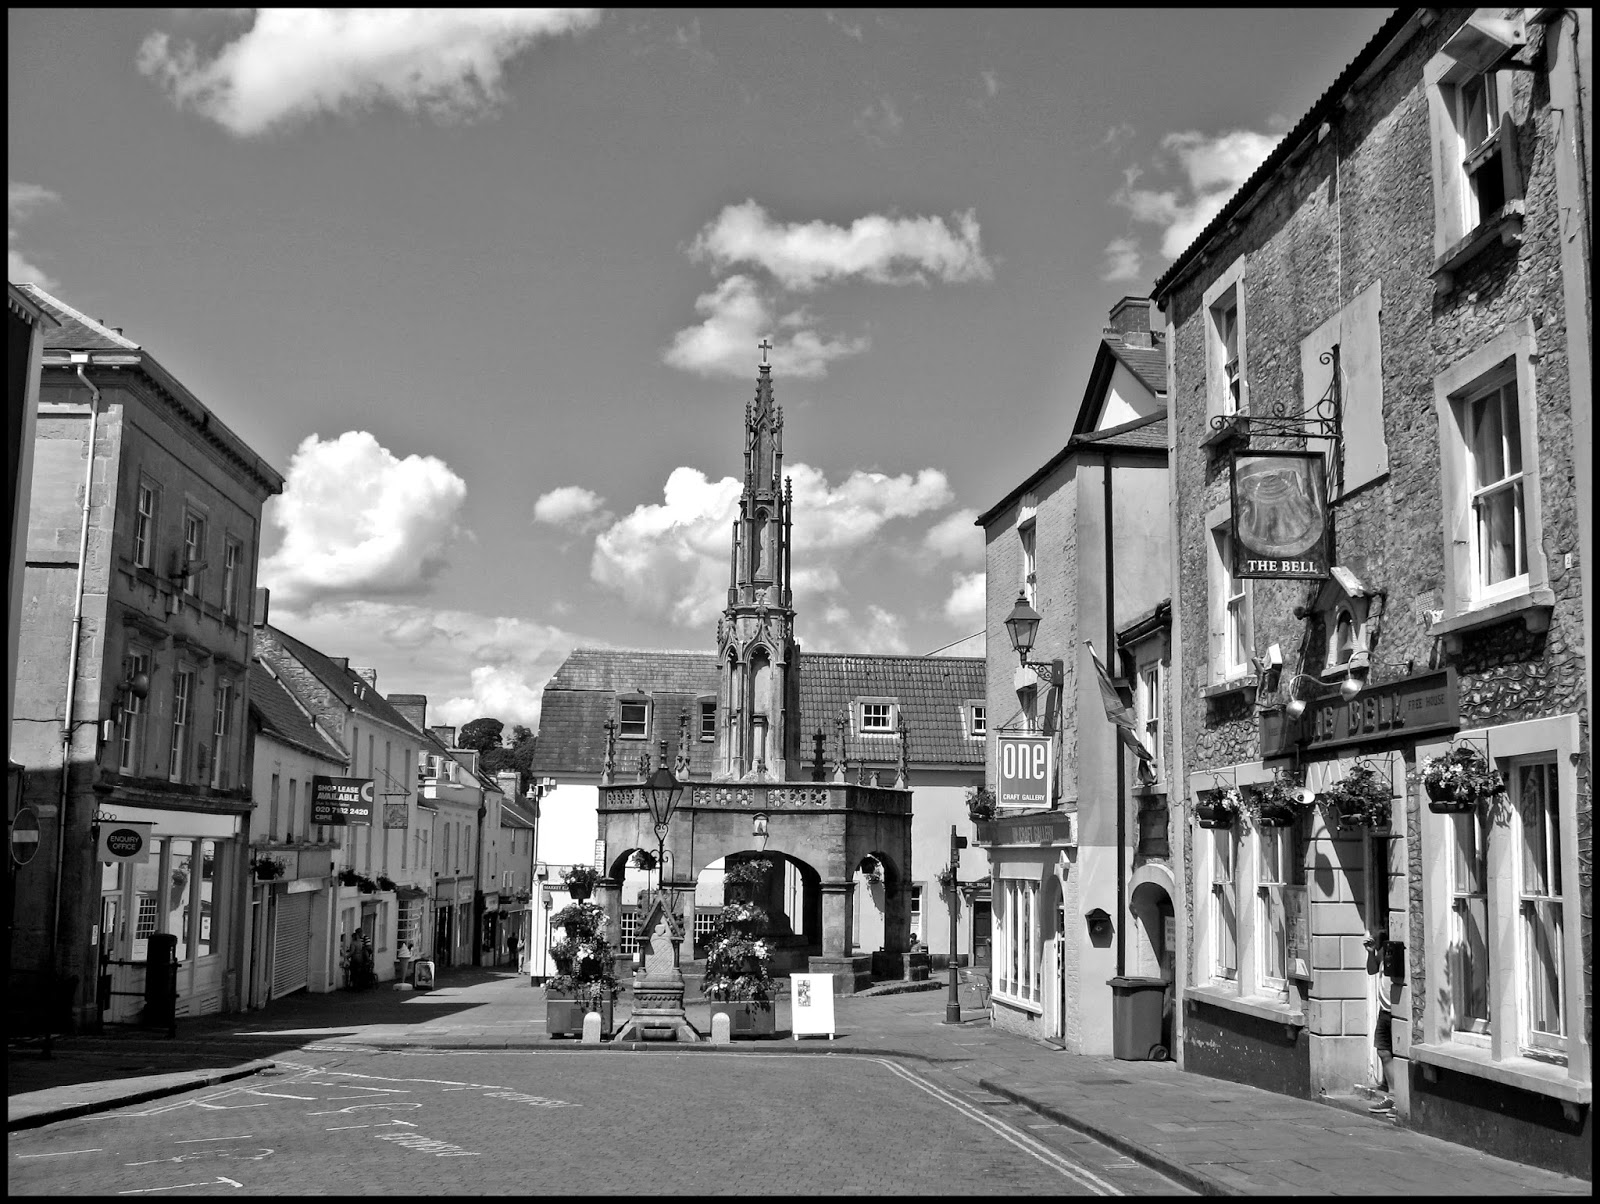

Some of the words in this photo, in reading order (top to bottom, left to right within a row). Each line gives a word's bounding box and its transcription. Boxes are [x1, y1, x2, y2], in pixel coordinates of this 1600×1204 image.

[1247, 560, 1278, 572] THE
[1281, 561, 1319, 573] BELL
[1348, 692, 1406, 730] BELL
[1003, 743, 1045, 780] one
[337, 785, 359, 793] LEASE
[316, 792, 359, 802] AVAILABLE
[349, 808, 369, 816] 2420
